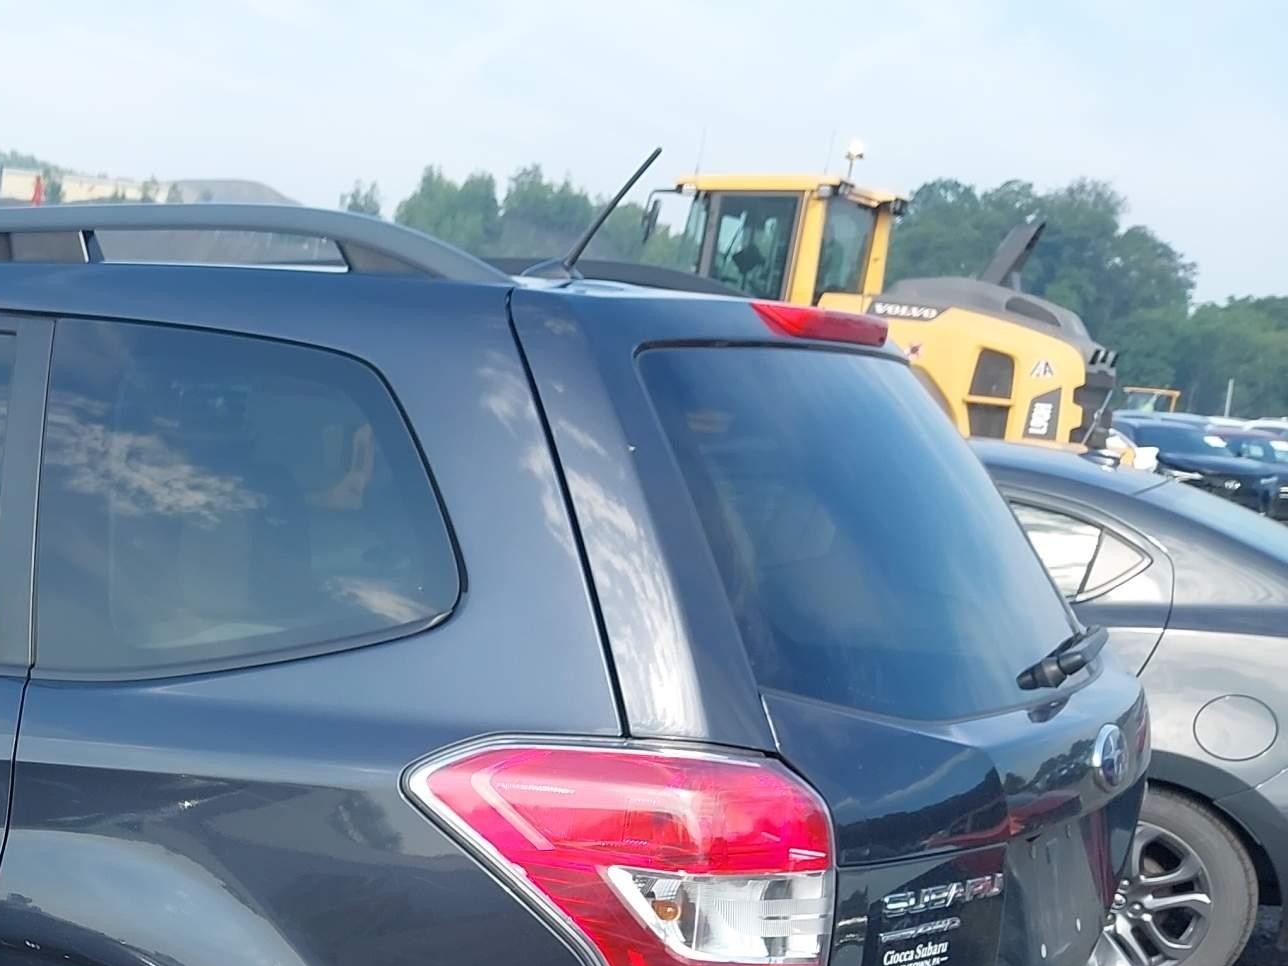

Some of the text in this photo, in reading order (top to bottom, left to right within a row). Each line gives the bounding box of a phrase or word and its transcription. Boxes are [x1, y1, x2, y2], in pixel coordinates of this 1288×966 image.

[874, 302, 939, 319] VOLVO
[882, 873, 1004, 918] SUBARU
[883, 941, 949, 966] Ciocca Subaru
